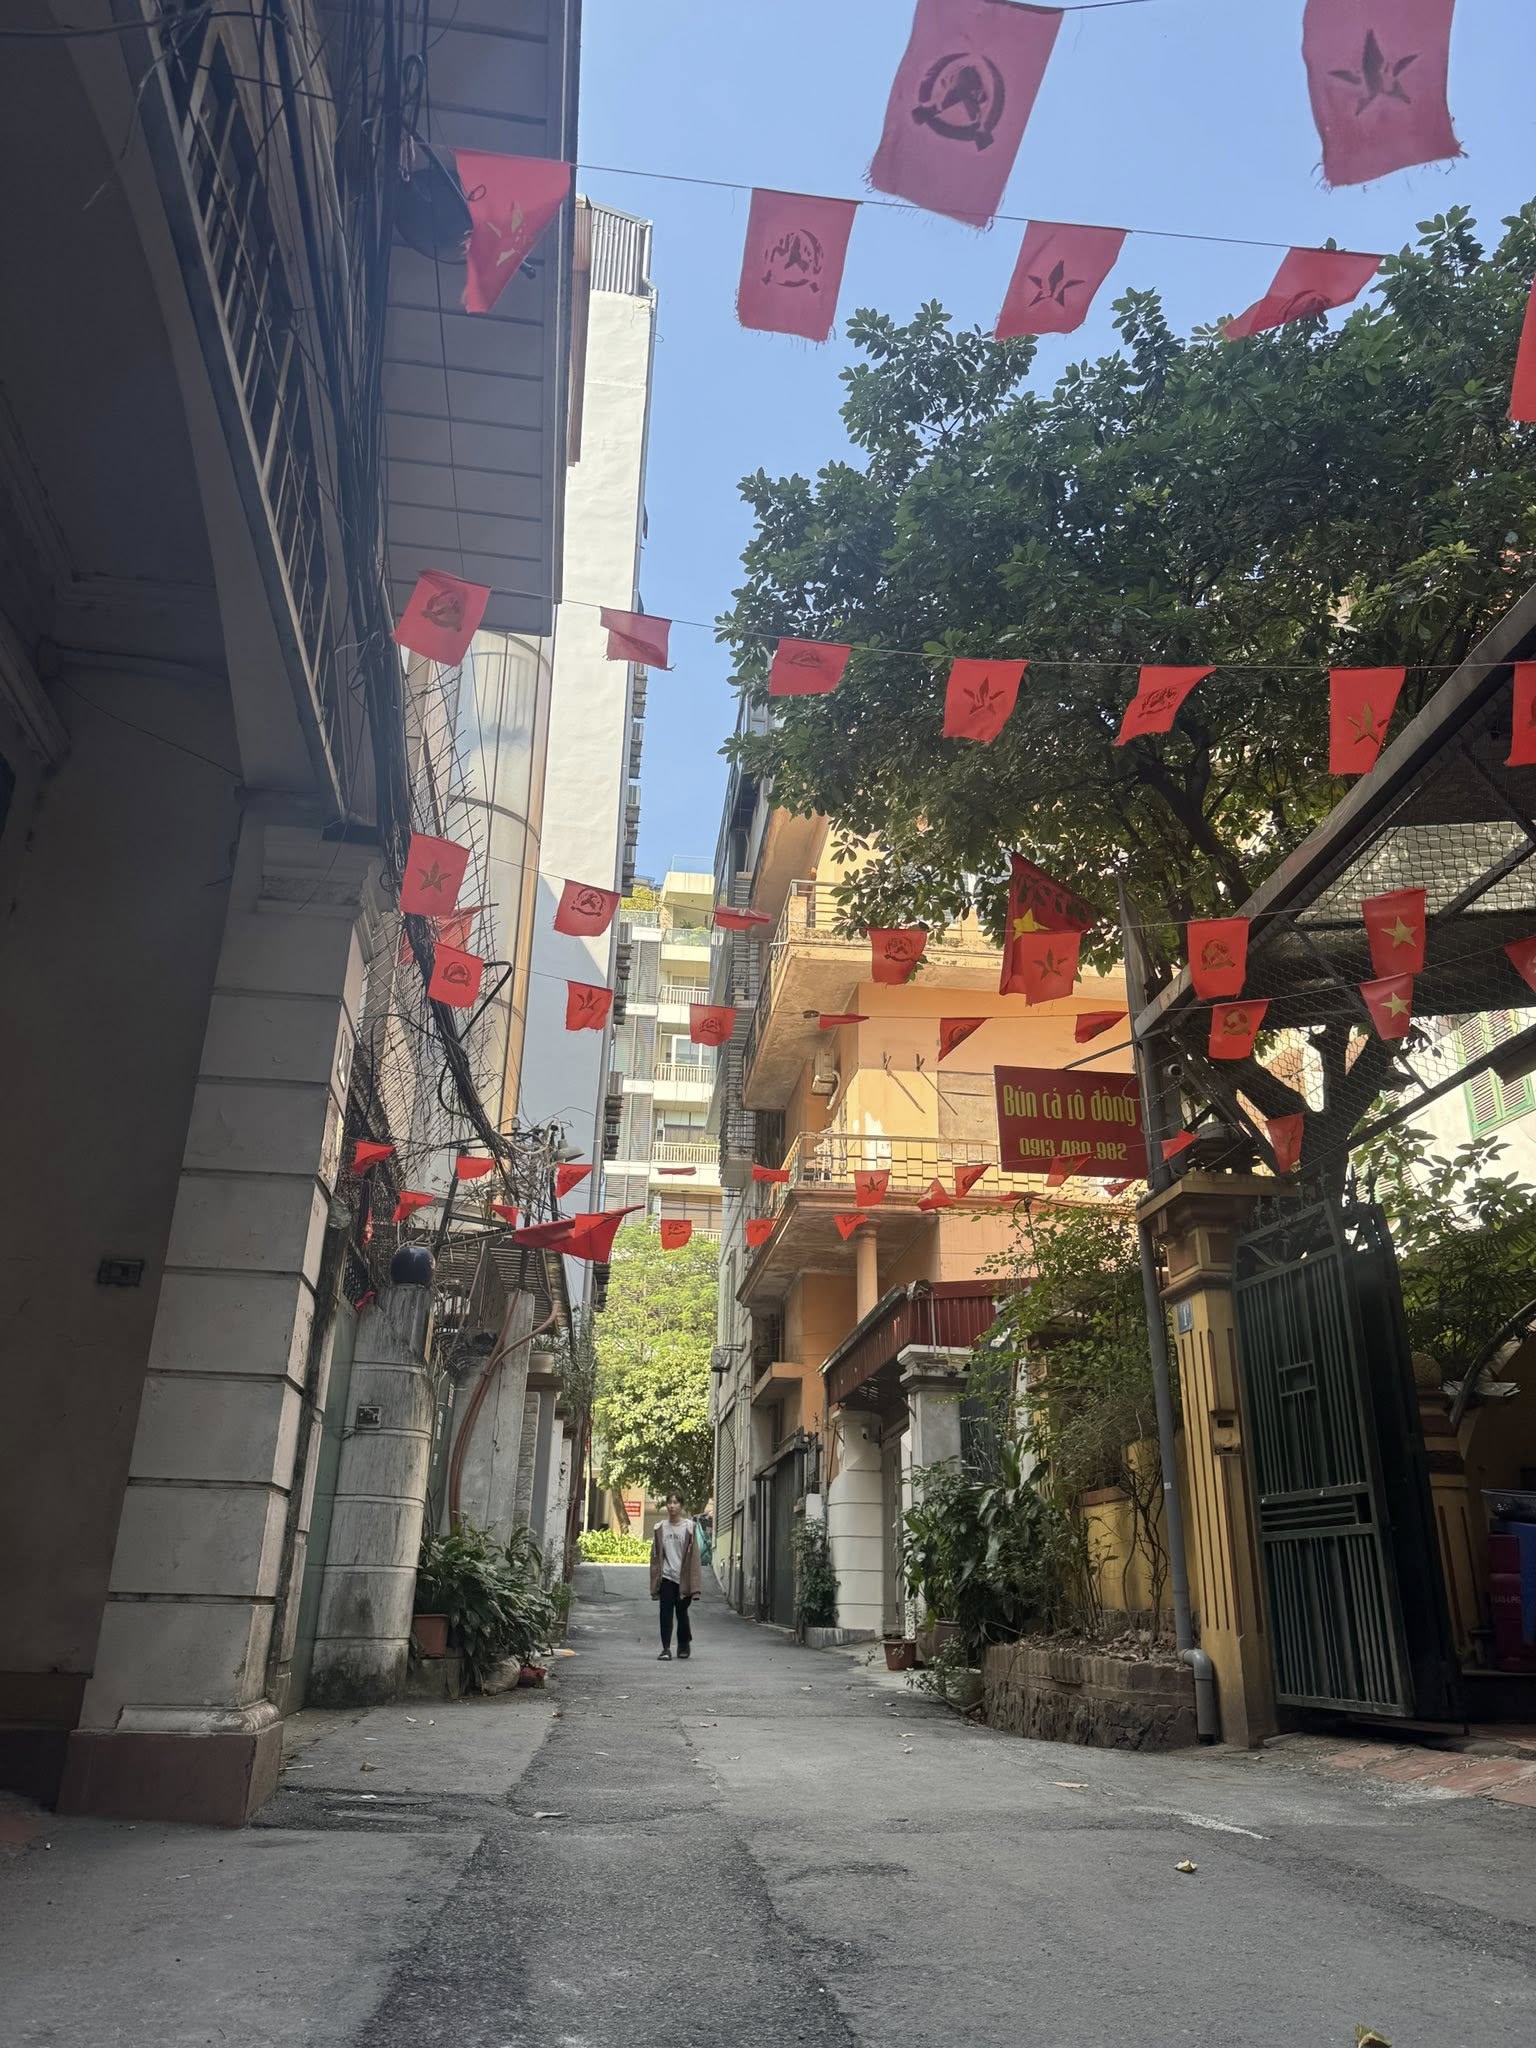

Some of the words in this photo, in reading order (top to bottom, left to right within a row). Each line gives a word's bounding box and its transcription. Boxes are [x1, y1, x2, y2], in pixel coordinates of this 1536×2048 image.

[1003, 1085, 1037, 1117] Bún
[1042, 1087, 1063, 1119] cá
[1067, 1089, 1085, 1121] rô
[1091, 1086, 1137, 1127] đồng
